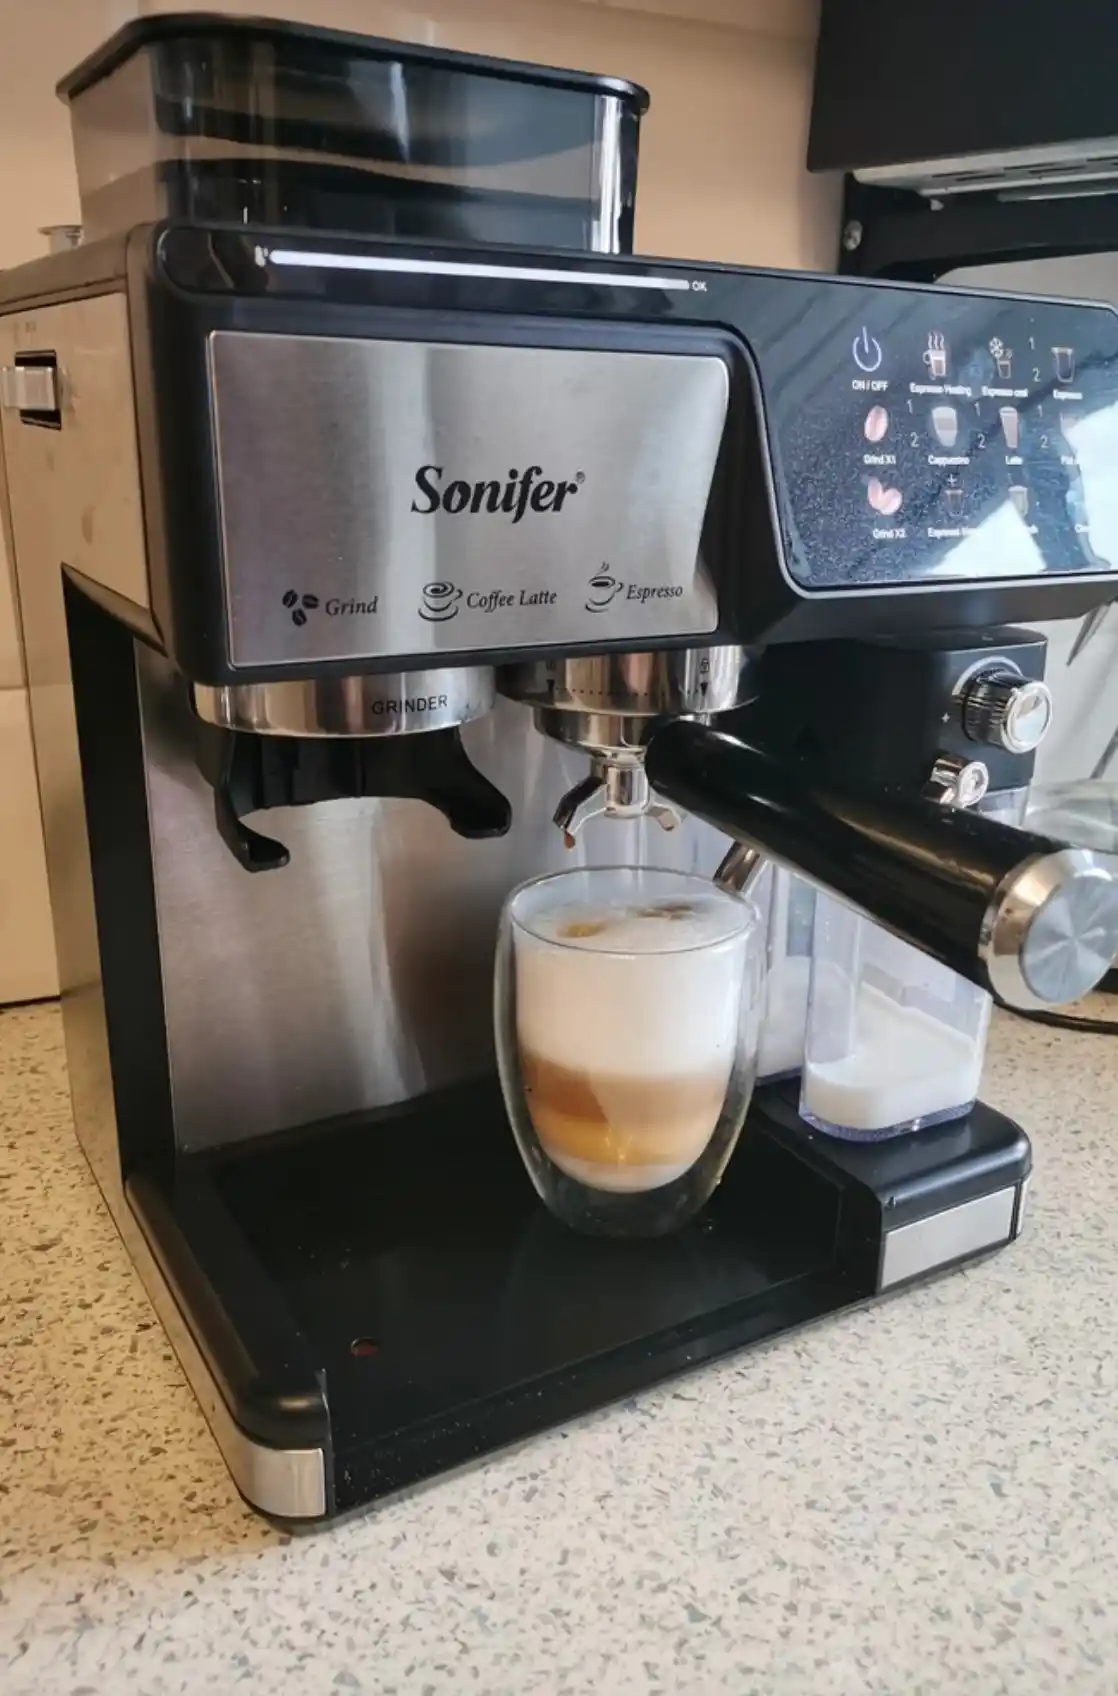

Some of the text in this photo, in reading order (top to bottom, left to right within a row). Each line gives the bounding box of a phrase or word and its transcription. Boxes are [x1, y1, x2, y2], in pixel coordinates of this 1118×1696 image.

[691, 279, 708, 292] OK
[1032, 367, 1041, 382] 2
[910, 431, 920, 448] 2
[977, 433, 986, 448] 2
[1040, 434, 1050, 449] 2
[466, 589, 558, 613] Coffee Latte
[626, 584, 684, 604] Espresso
[325, 595, 379, 617] Grind
[371, 694, 449, 715] GRINDER
